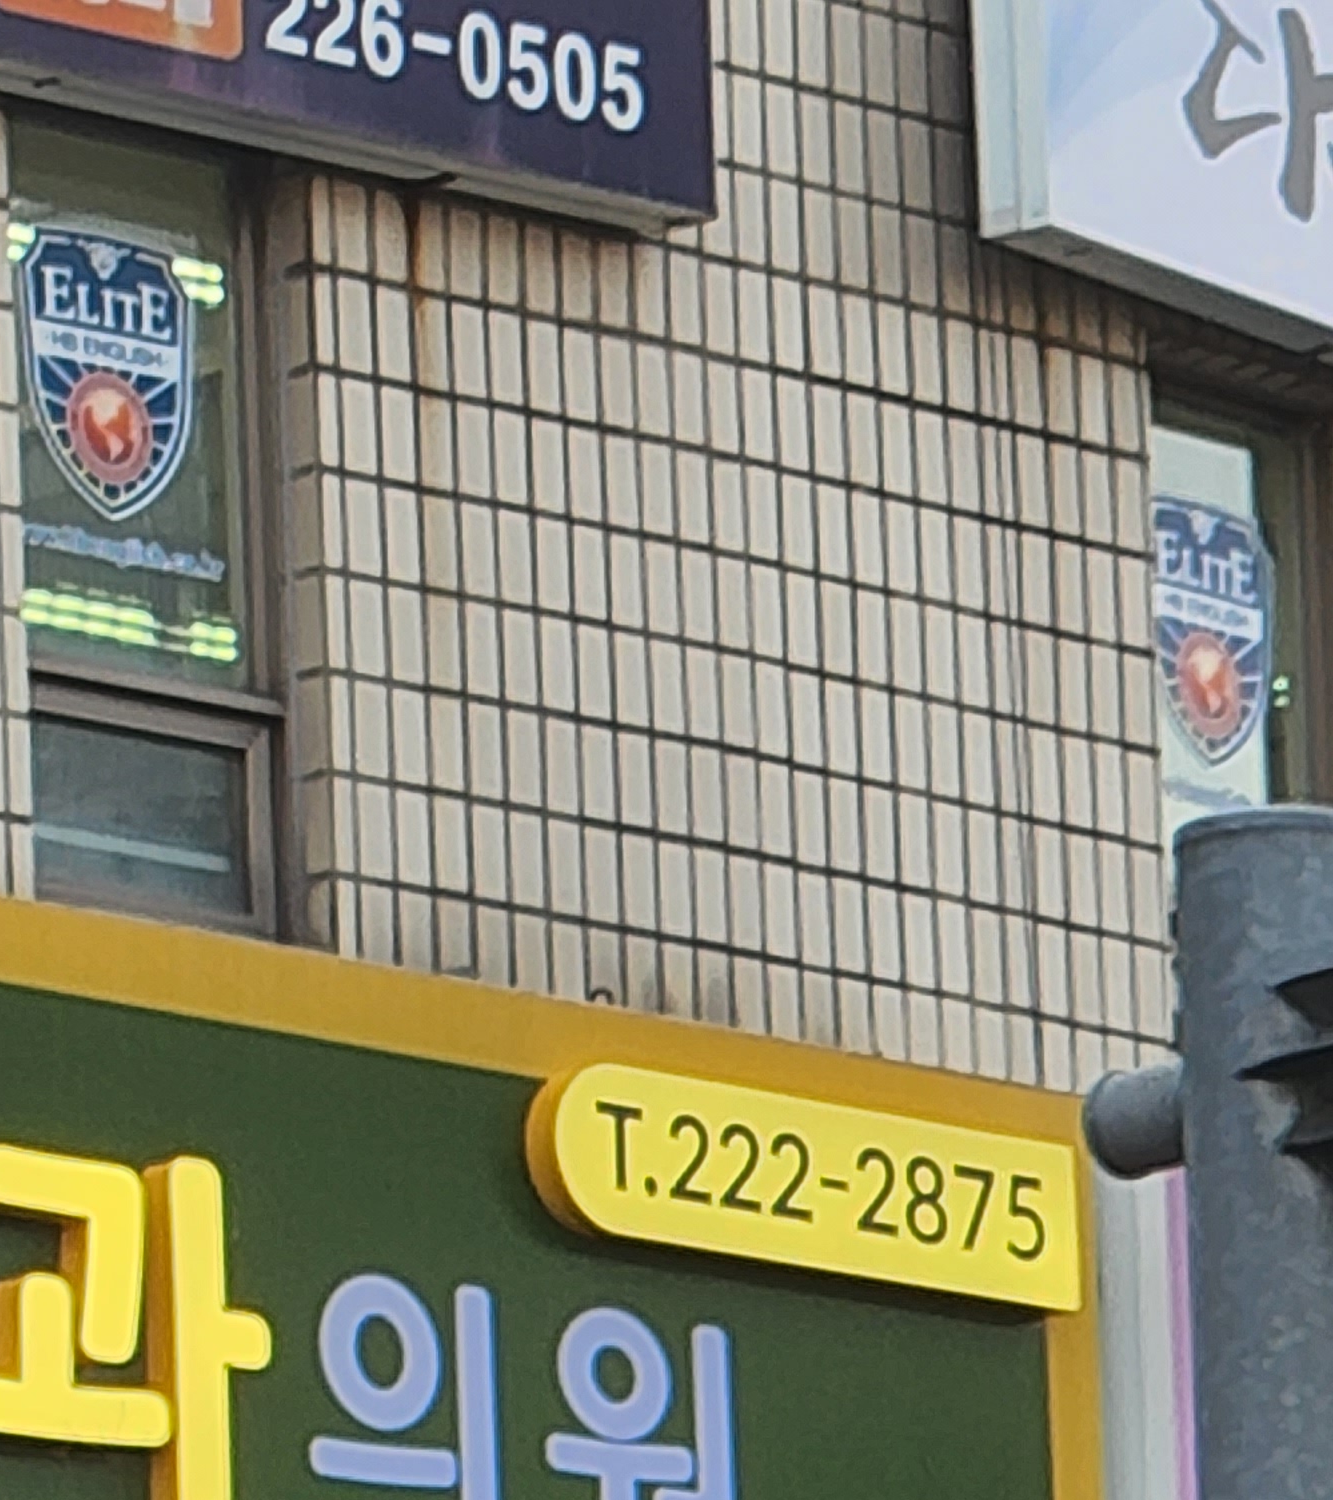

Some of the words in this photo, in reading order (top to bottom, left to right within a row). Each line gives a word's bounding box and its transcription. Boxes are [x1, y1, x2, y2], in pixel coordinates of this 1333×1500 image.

[265, 0, 645, 132] 226-0505
[40, 264, 173, 342] ELITE
[594, 1098, 1047, 1262] T.222-2875
